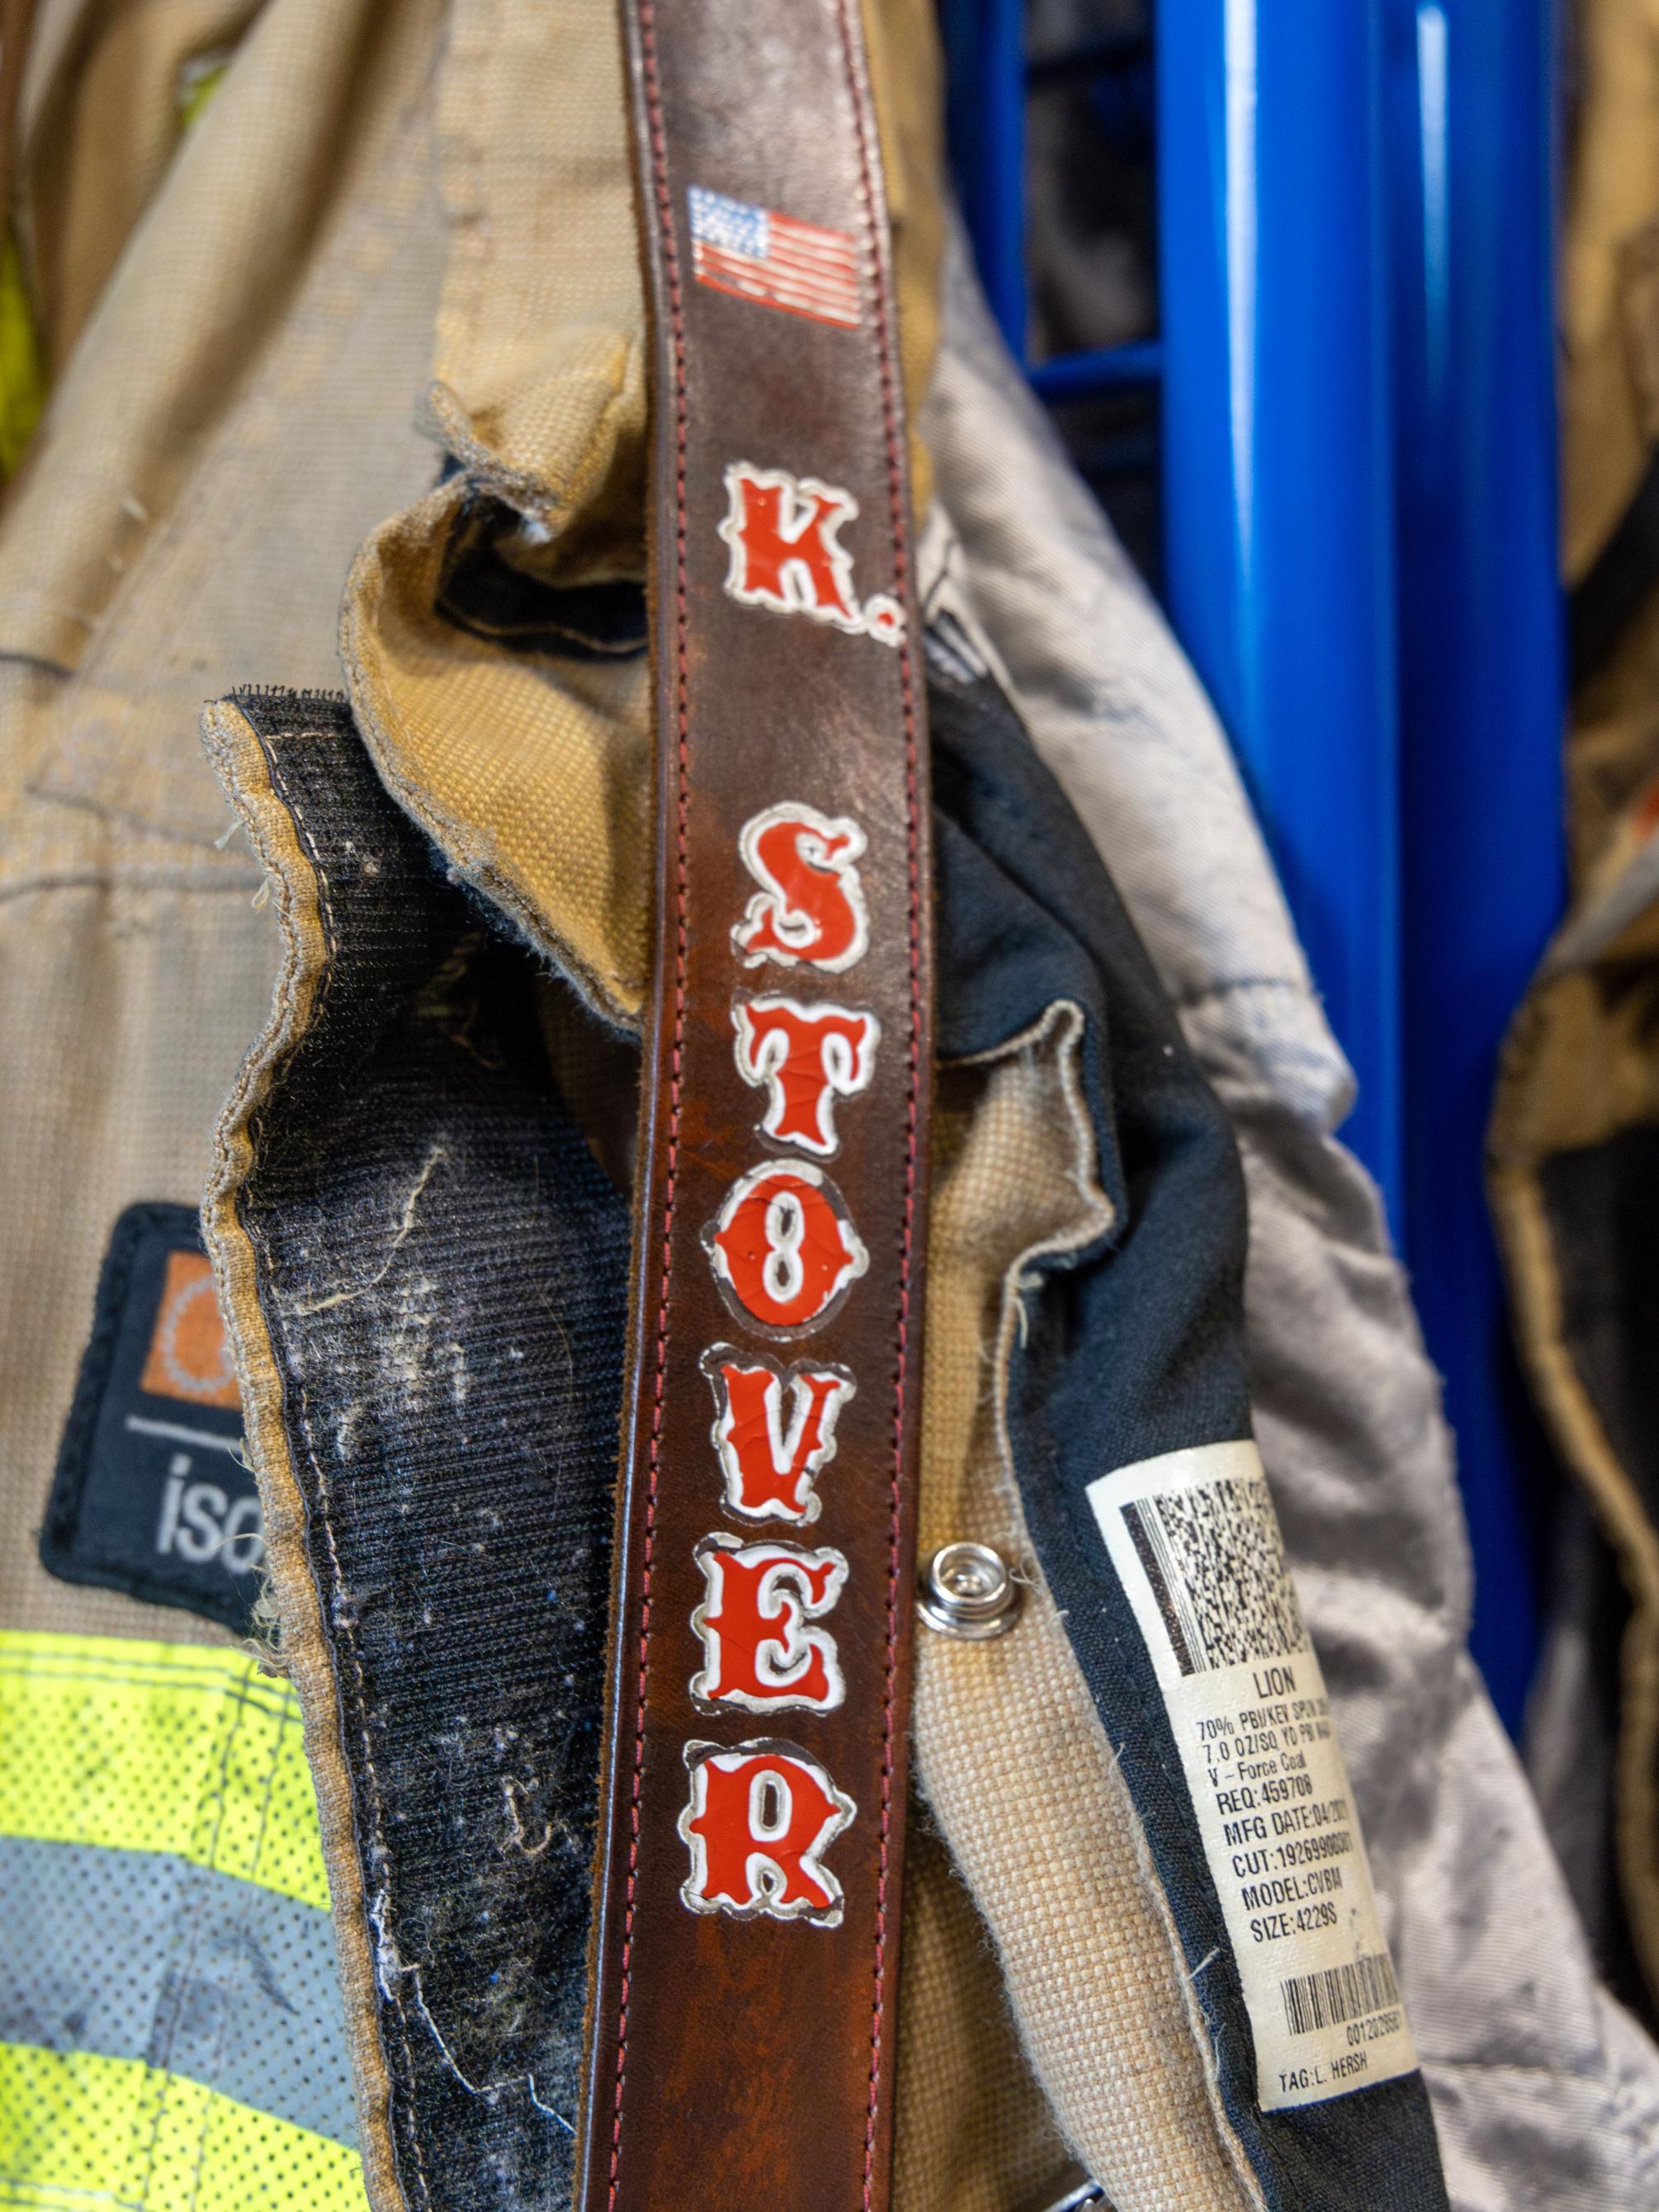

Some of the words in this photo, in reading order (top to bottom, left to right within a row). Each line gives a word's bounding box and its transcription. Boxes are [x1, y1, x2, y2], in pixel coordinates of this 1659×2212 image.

[717, 459, 908, 648] K.
[680, 801, 880, 1927] STOVER
[1253, 1666, 1297, 1699] LION
[1197, 1716, 1235, 1742] 70%
[1240, 1704, 1289, 1732] PBI/KEV
[1202, 1742, 1230, 1764] 7.0
[1238, 1761, 1279, 1781] Force
[1216, 1774, 1314, 1815] REQ:459708
[1223, 1816, 1268, 1846] MFG
[1241, 1866, 1344, 1912] MODEL:CVBM
[1250, 1901, 1338, 1943] SIZE:4229S
[1331, 2051, 1368, 2079] HERSH
